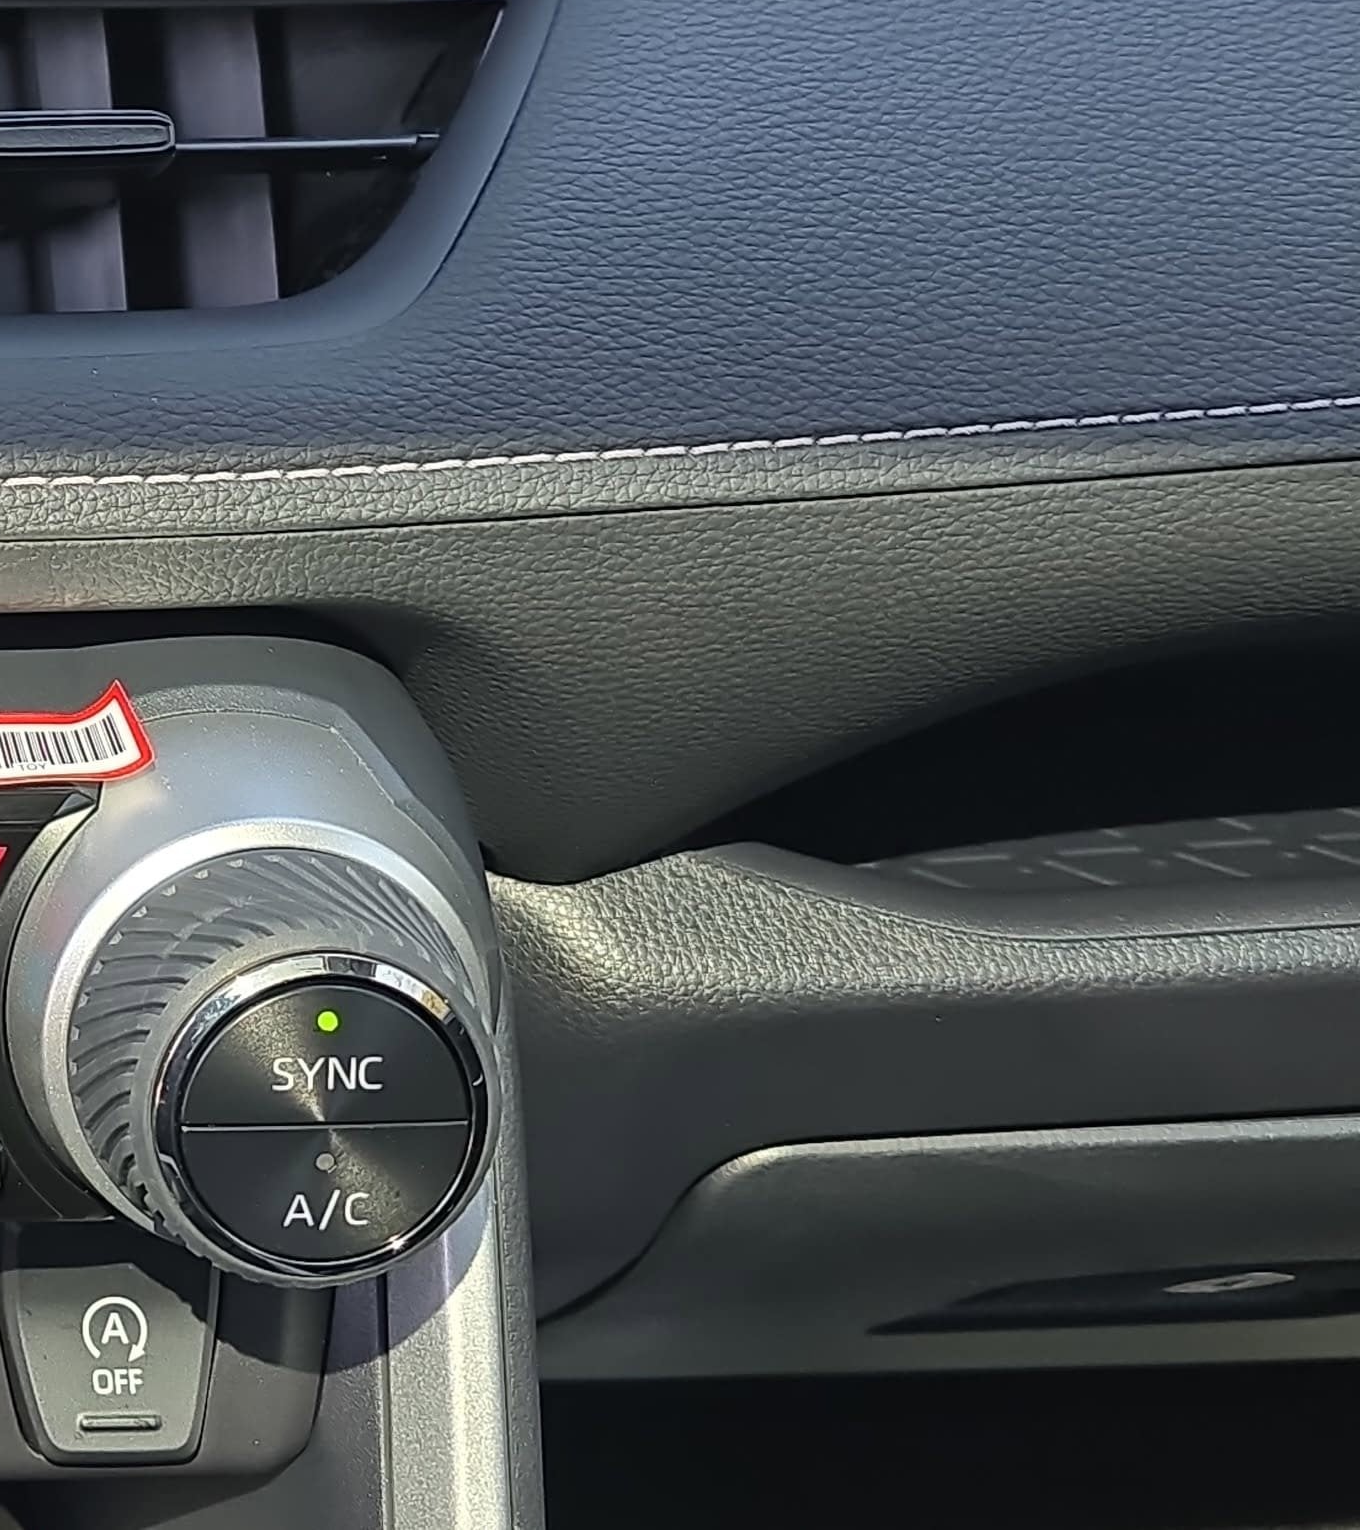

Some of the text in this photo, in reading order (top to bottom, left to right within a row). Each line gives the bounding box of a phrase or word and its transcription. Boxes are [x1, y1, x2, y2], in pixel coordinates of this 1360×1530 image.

[271, 1055, 383, 1092] SYNC
[283, 1191, 370, 1231] A/C
[91, 1368, 143, 1396] OFF
